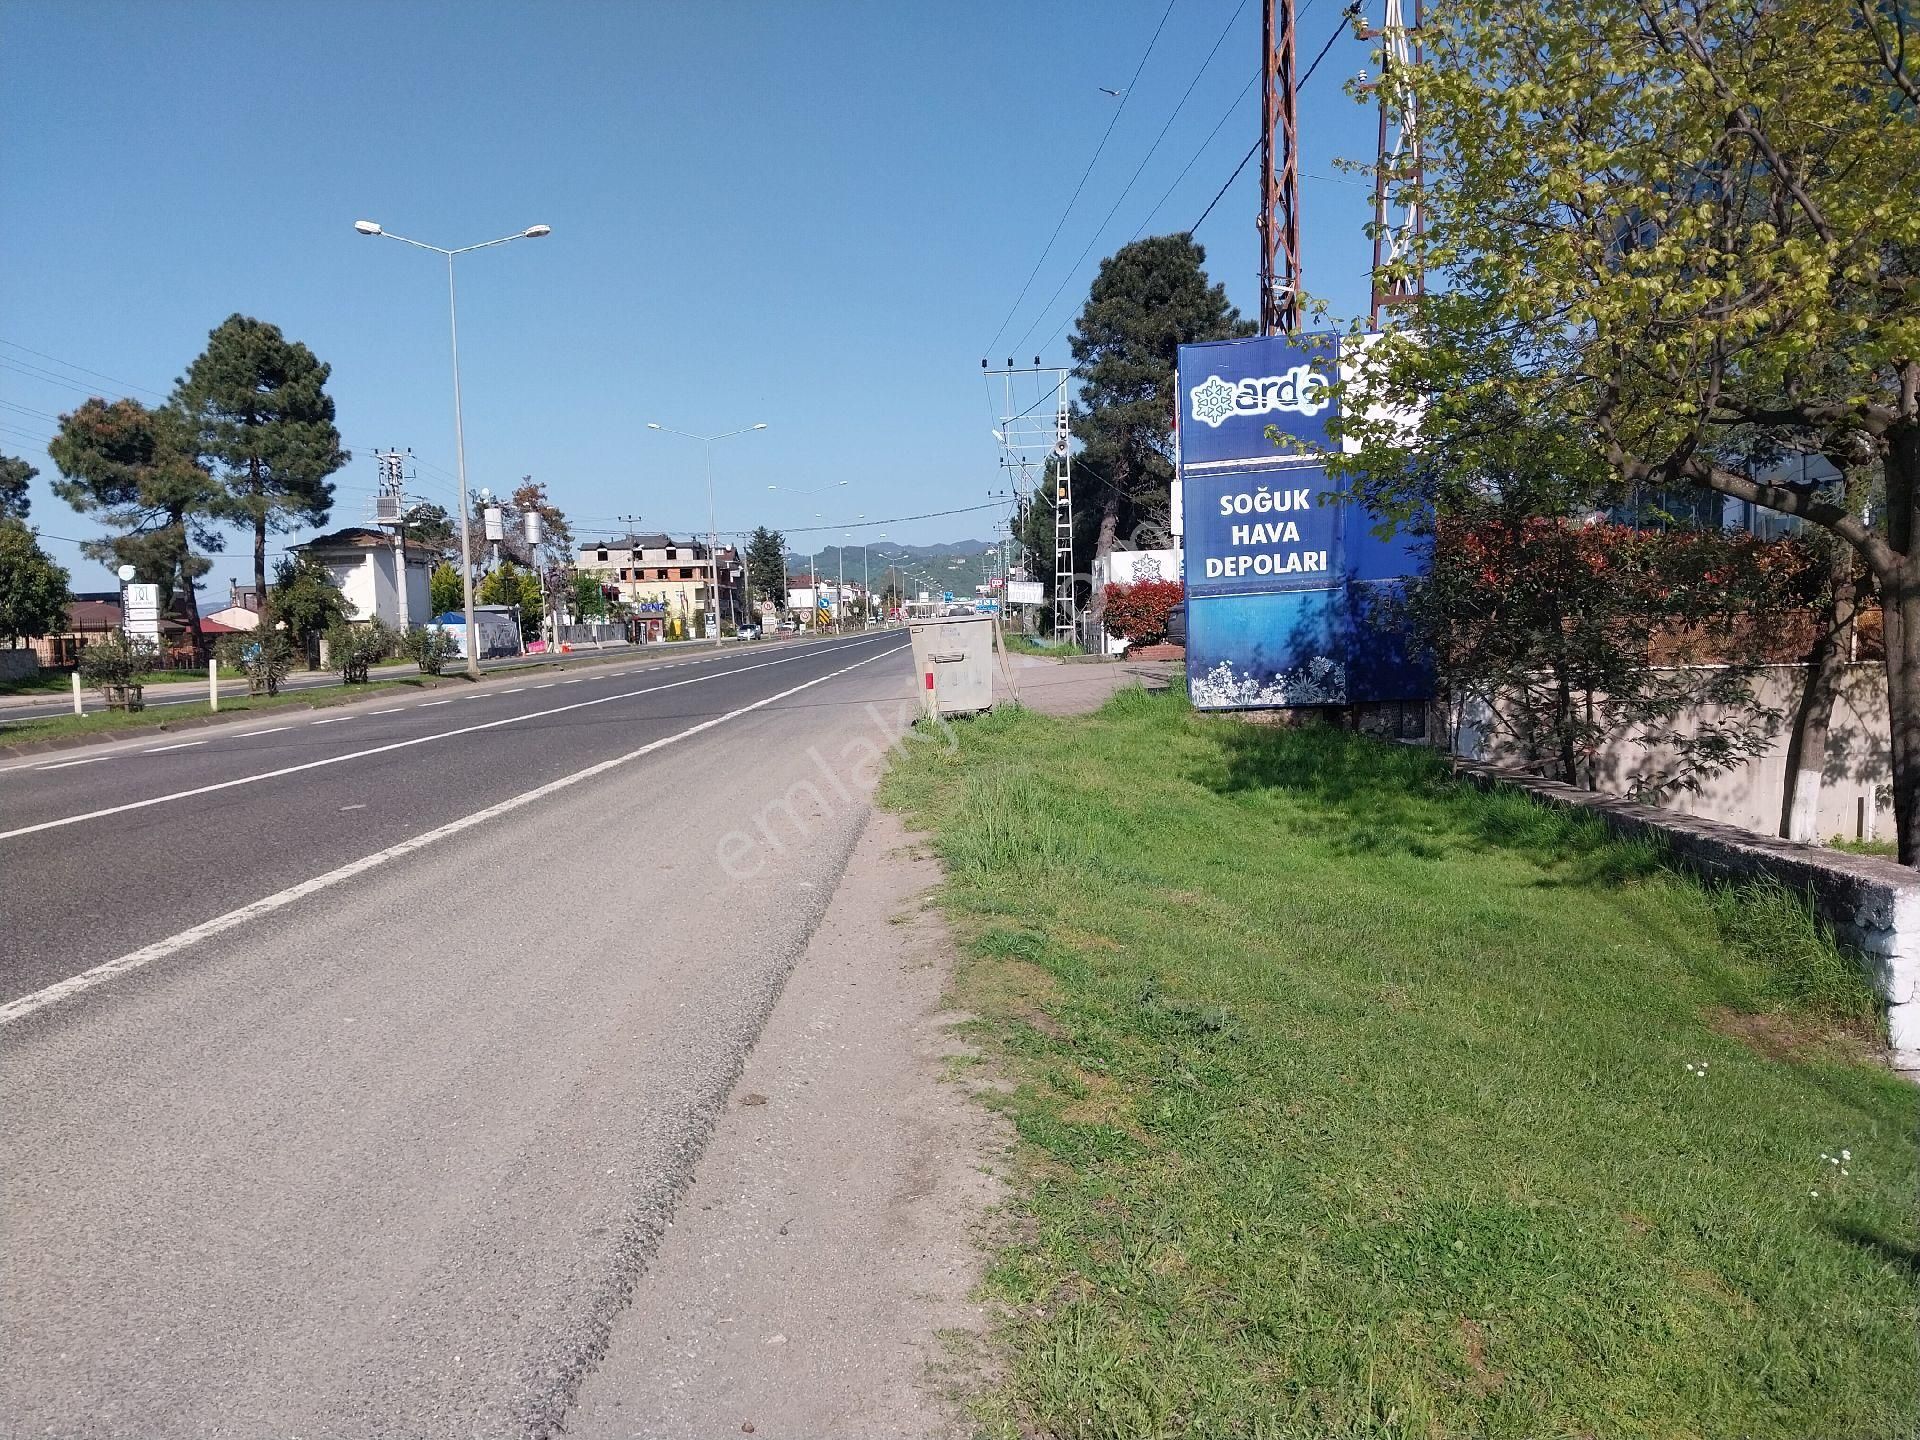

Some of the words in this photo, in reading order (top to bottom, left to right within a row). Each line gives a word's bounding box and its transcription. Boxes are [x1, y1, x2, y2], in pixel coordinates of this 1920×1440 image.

[1235, 371, 1325, 410] arda
[1220, 484, 1310, 516] SOĞUK
[1231, 521, 1300, 546] HAVA
[1205, 550, 1328, 578] DEPOLARI
